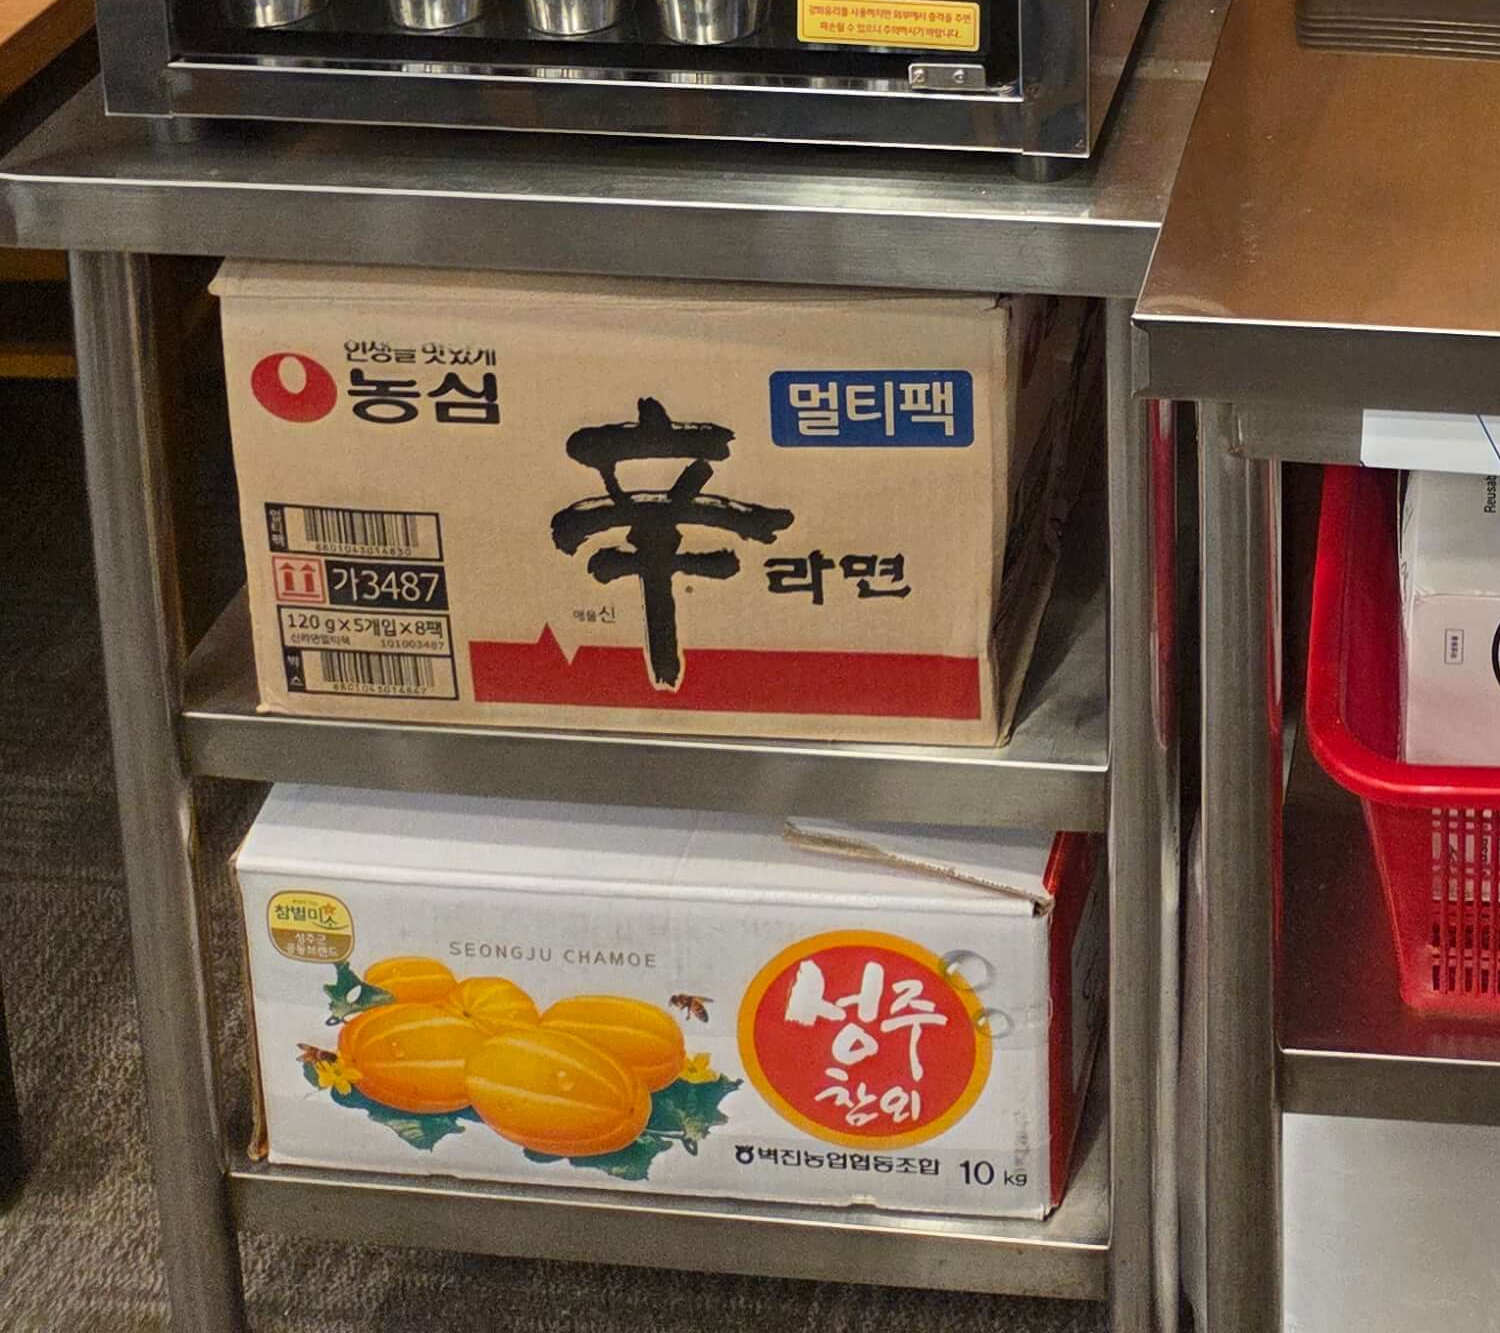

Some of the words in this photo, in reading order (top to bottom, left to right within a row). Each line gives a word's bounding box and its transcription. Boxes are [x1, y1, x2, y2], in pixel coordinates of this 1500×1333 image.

[344, 339, 416, 363] 인생을
[347, 368, 500, 424] 농심
[788, 381, 953, 437] 멀티팩
[1484, 476, 1498, 514] Reusab
[551, 397, 795, 687] 辛
[332, 567, 439, 602] 가3487
[763, 549, 911, 605] 라면
[287, 614, 320, 629] 120
[449, 941, 552, 962] SEONGJU
[563, 949, 657, 968] CHAMOE
[785, 959, 948, 1082] 성주
[814, 1067, 920, 1126] 참외
[758, 1146, 940, 1176] 벽진농업협동조합
[960, 1160, 994, 1185] 10
[1004, 1170, 1028, 1186] kg
